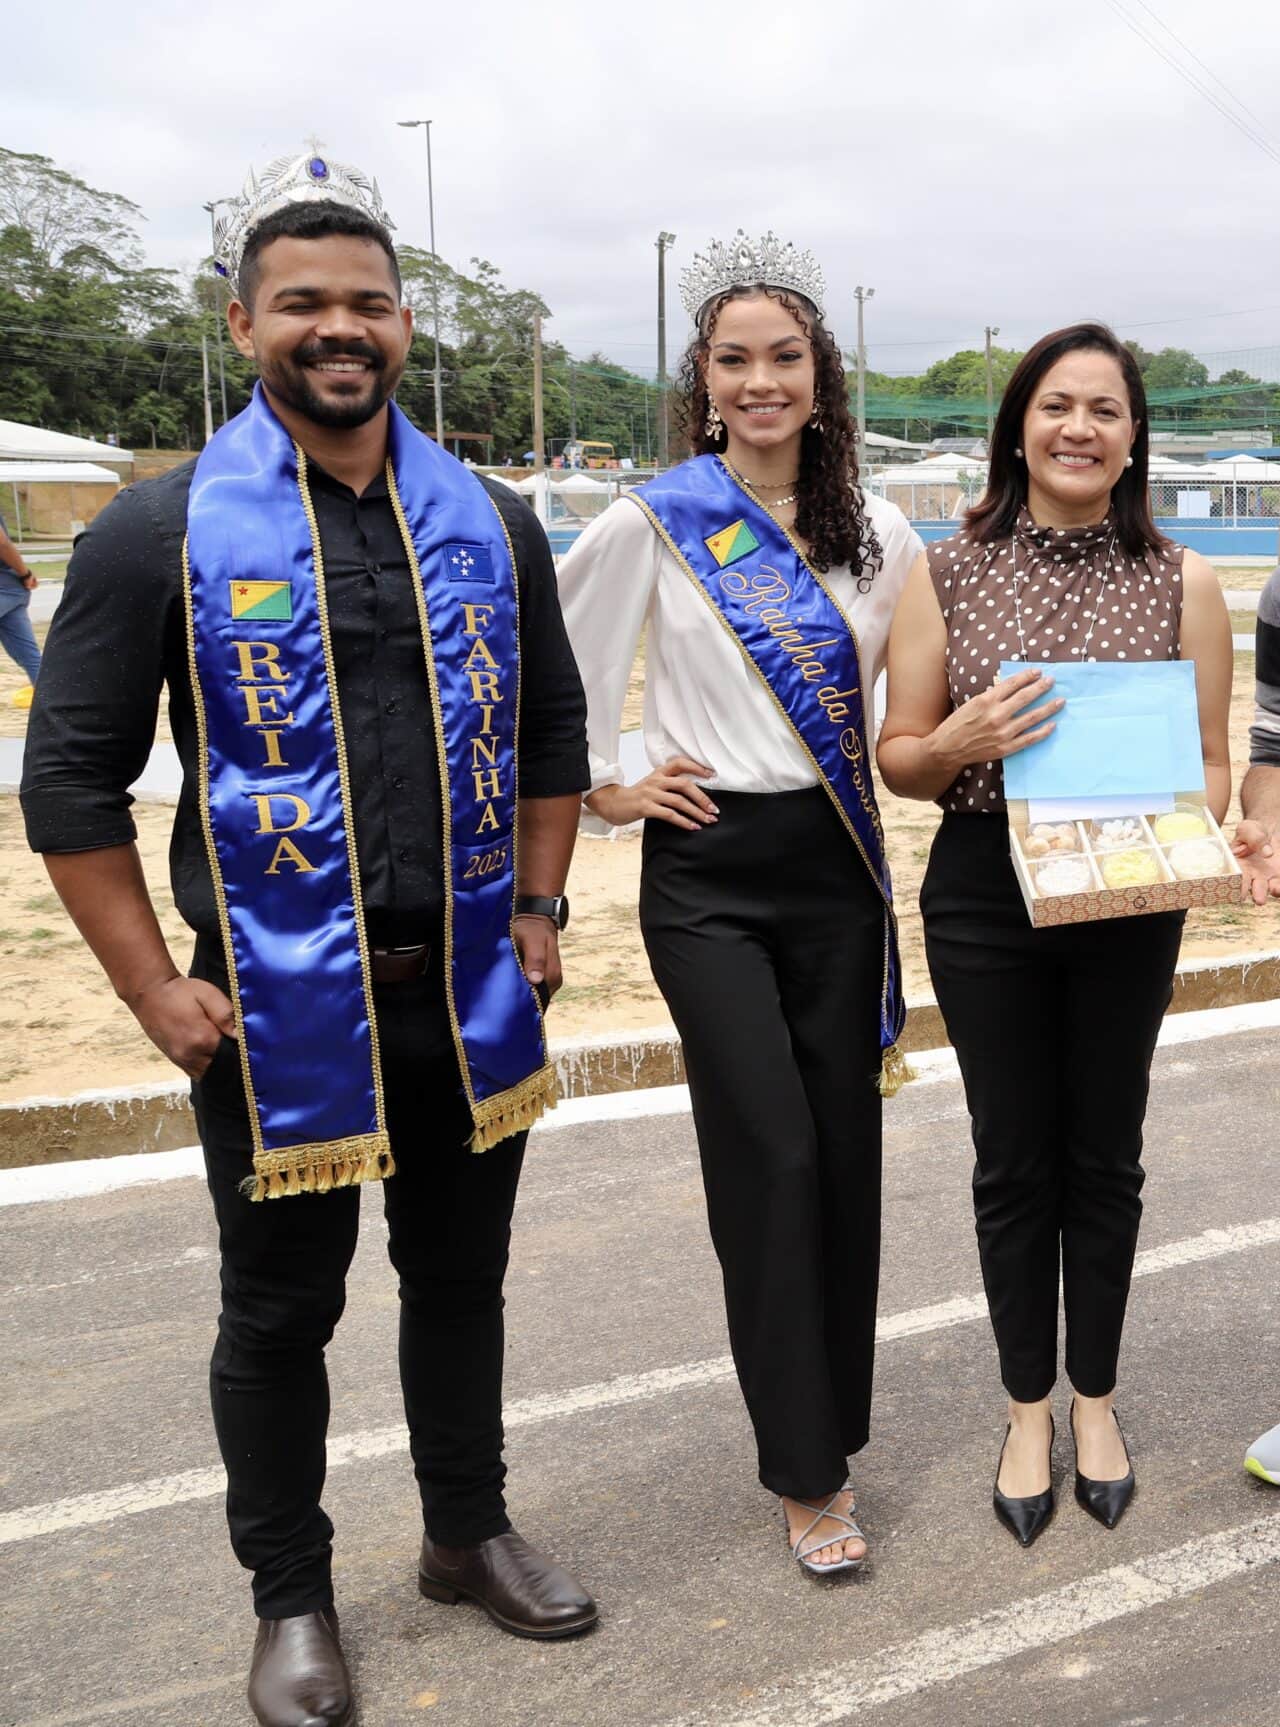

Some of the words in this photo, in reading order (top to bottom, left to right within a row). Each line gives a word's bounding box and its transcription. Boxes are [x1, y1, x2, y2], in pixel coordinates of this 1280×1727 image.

[230, 640, 295, 767] REI
[459, 602, 504, 834] FARINHA
[719, 564, 838, 684] Rainha
[816, 687, 859, 724] da
[838, 727, 886, 854] Farin
[250, 792, 320, 875] DA
[463, 845, 509, 880] 2025
